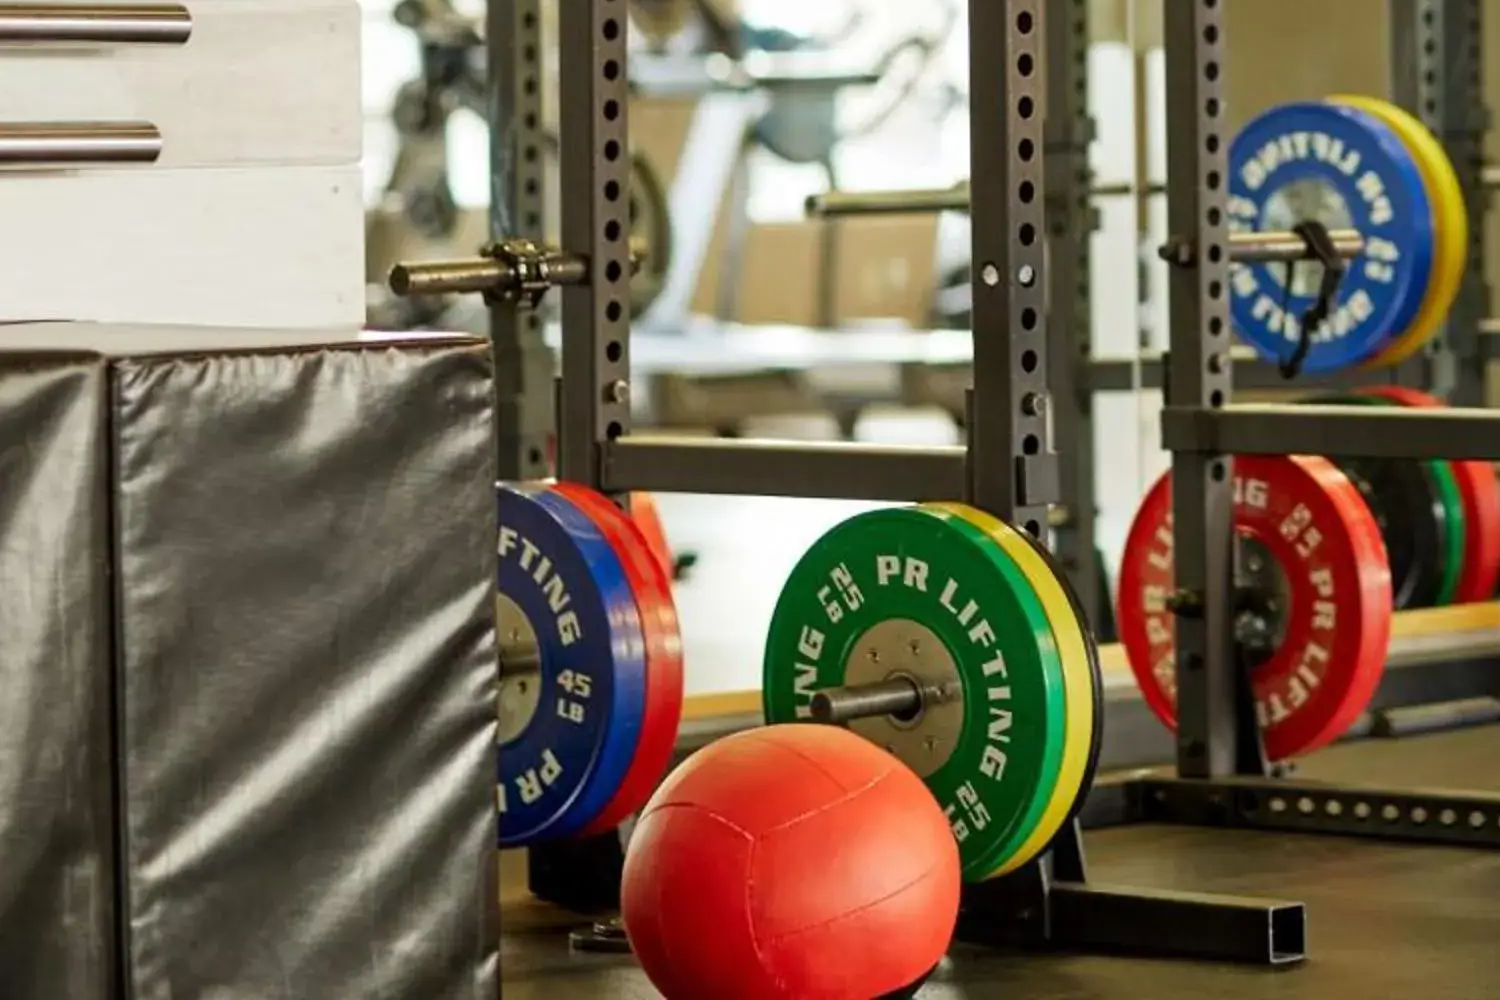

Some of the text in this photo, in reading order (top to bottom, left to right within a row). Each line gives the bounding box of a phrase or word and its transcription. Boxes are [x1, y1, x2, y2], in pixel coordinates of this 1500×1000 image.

[498, 525, 582, 646] FTING
[816, 584, 844, 624] LB
[829, 562, 865, 613] 25
[556, 668, 592, 699] 45
[876, 554, 1013, 781] PR LIFTING
[1257, 641, 1329, 727] LIFTI
[556, 698, 585, 724] LB
[514, 748, 563, 805] PR
[955, 780, 992, 831] 25
